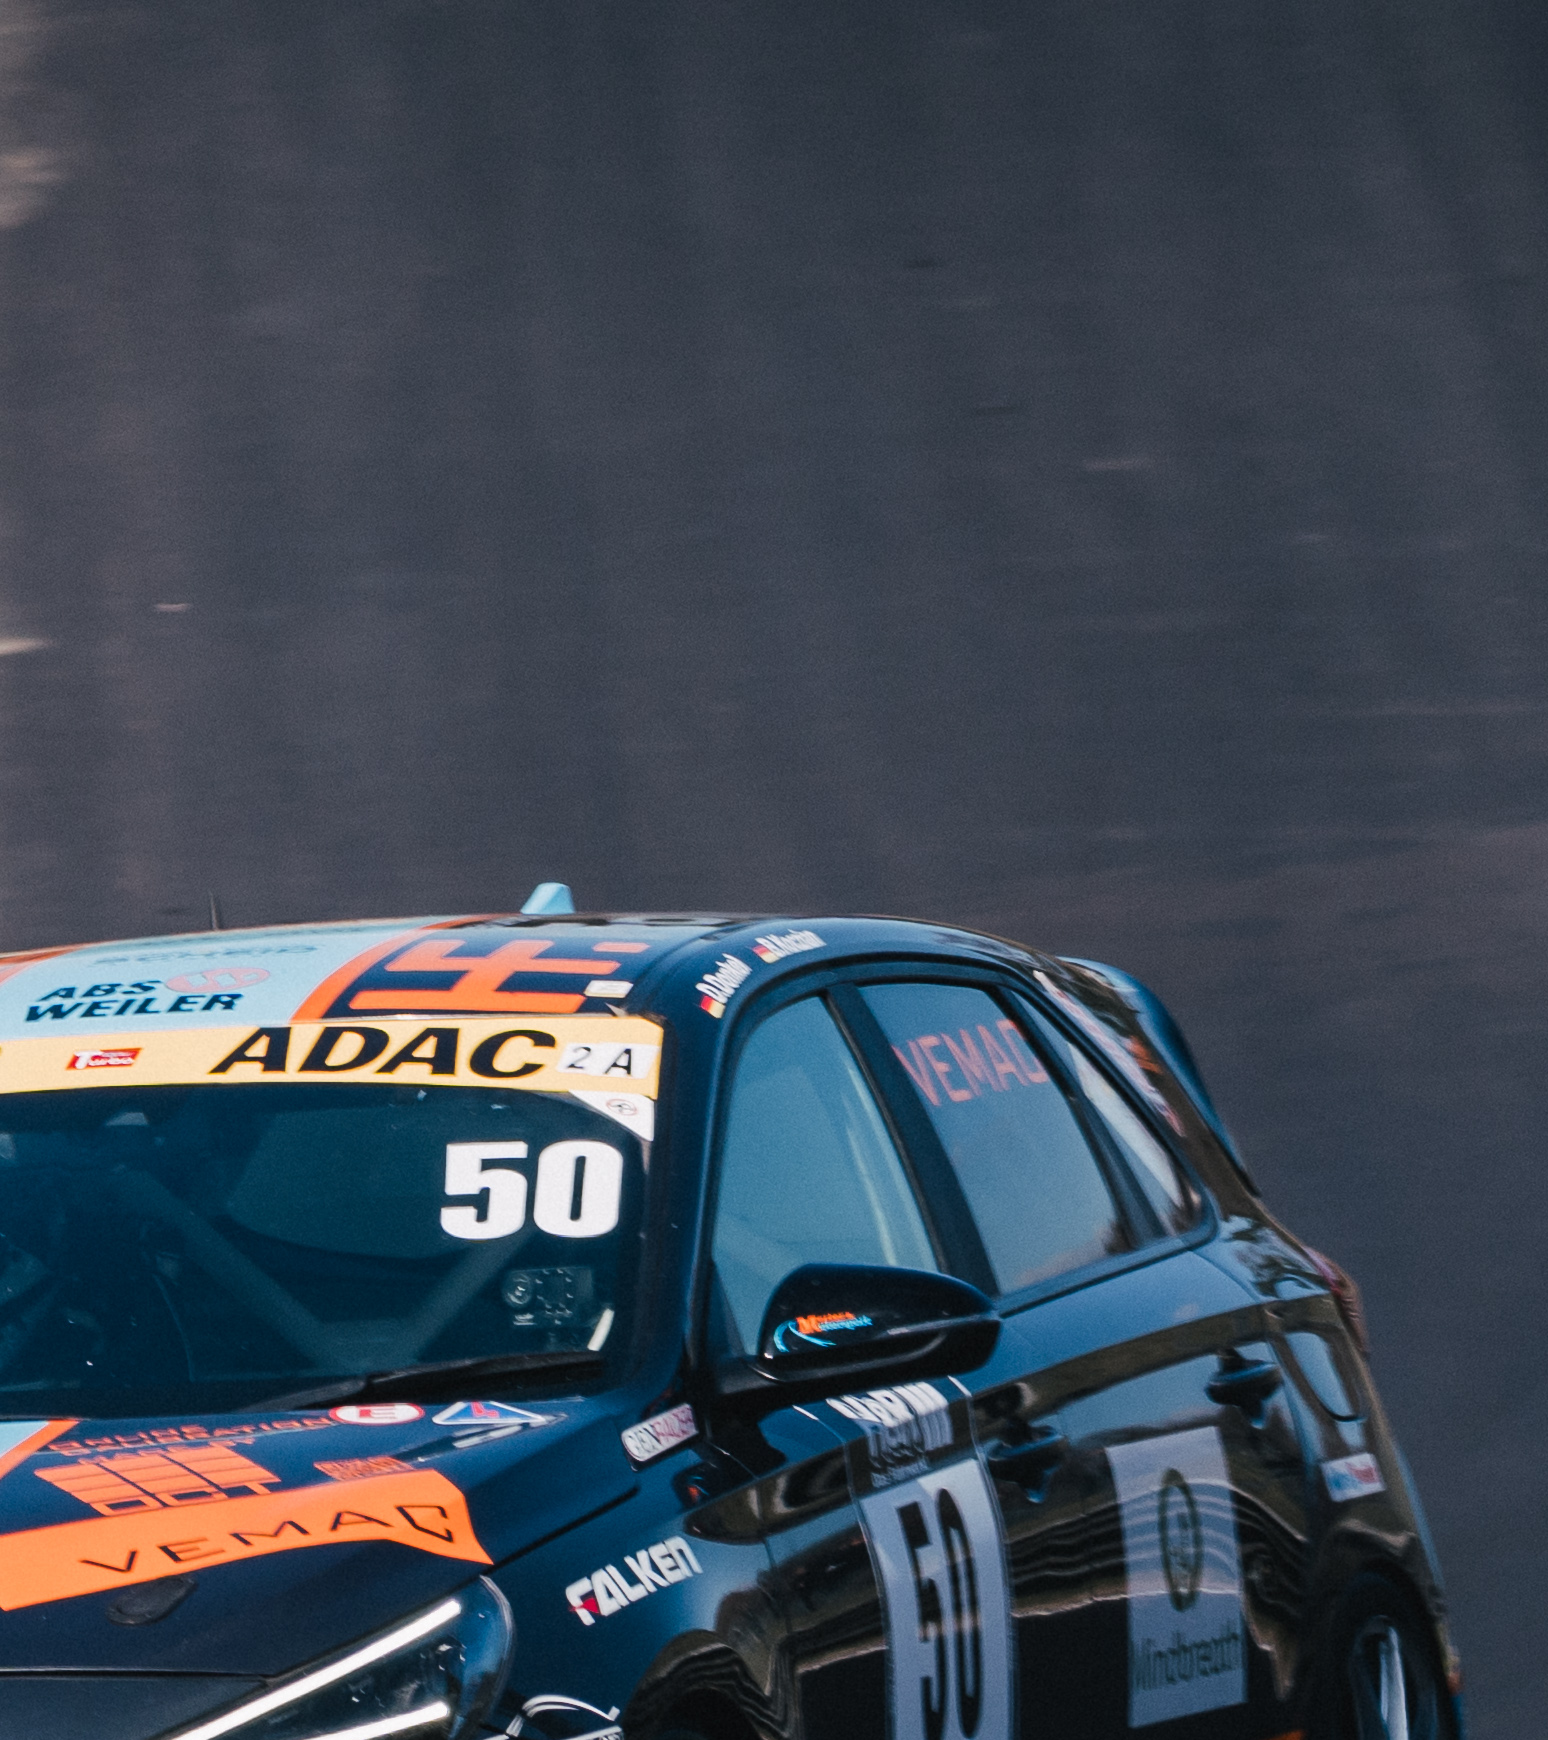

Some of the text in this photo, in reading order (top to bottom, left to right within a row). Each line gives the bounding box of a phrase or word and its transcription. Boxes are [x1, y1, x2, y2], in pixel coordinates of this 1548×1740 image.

[25, 993, 244, 1022] WEILER
[41, 980, 164, 1000] ABS
[209, 1026, 556, 1079] ADAC
[441, 1140, 624, 1240] 50
[565, 1536, 703, 1626] FALKEN
